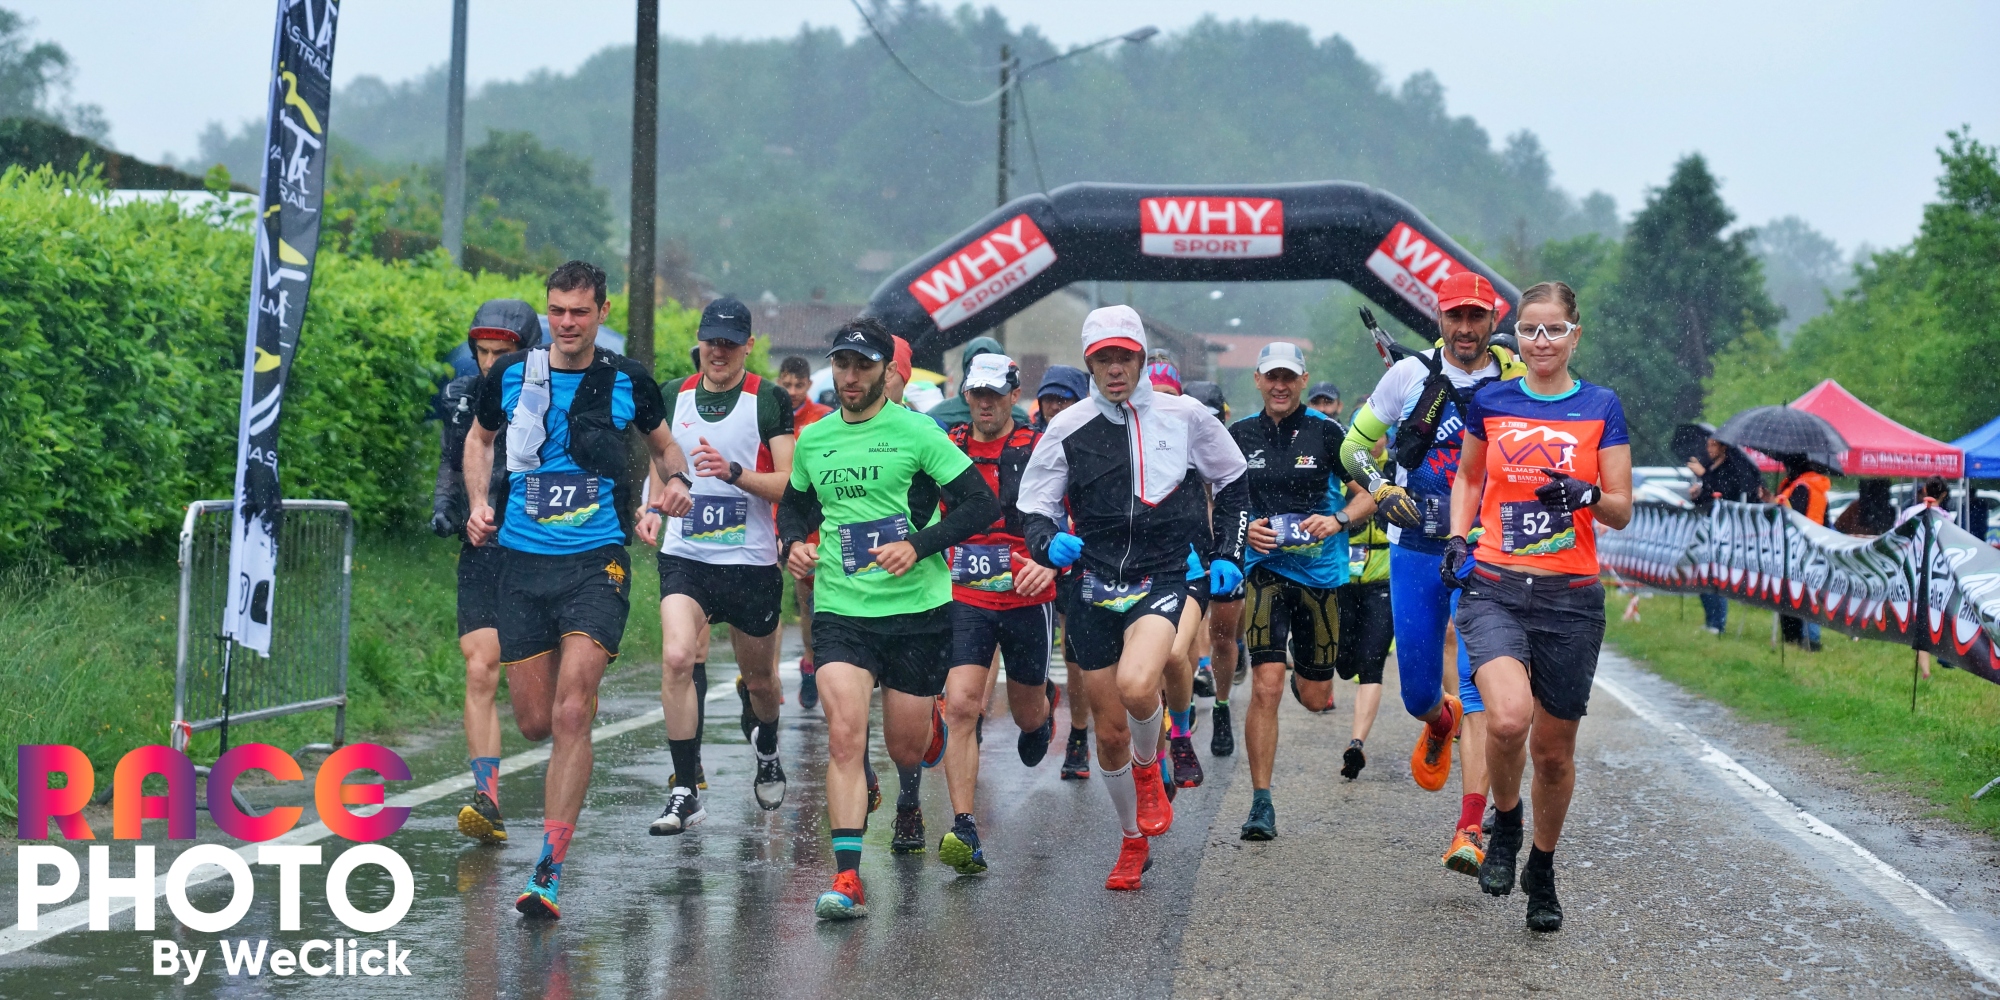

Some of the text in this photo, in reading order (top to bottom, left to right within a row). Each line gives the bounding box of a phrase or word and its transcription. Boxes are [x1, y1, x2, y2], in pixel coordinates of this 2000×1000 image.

[1147, 199, 1275, 233] WHY
[1172, 238, 1253, 253] SPORT
[915, 218, 1028, 304] WHY
[1393, 226, 1452, 289] WH
[961, 262, 1029, 313] SPORT
[1391, 272, 1440, 312] SPO
[819, 465, 884, 486] ZENIT
[549, 485, 577, 507] 27
[835, 484, 867, 501] PUB
[702, 505, 725, 526] 61
[1523, 511, 1552, 536] 52
[867, 531, 880, 550] 7
[968, 554, 991, 575] 36
